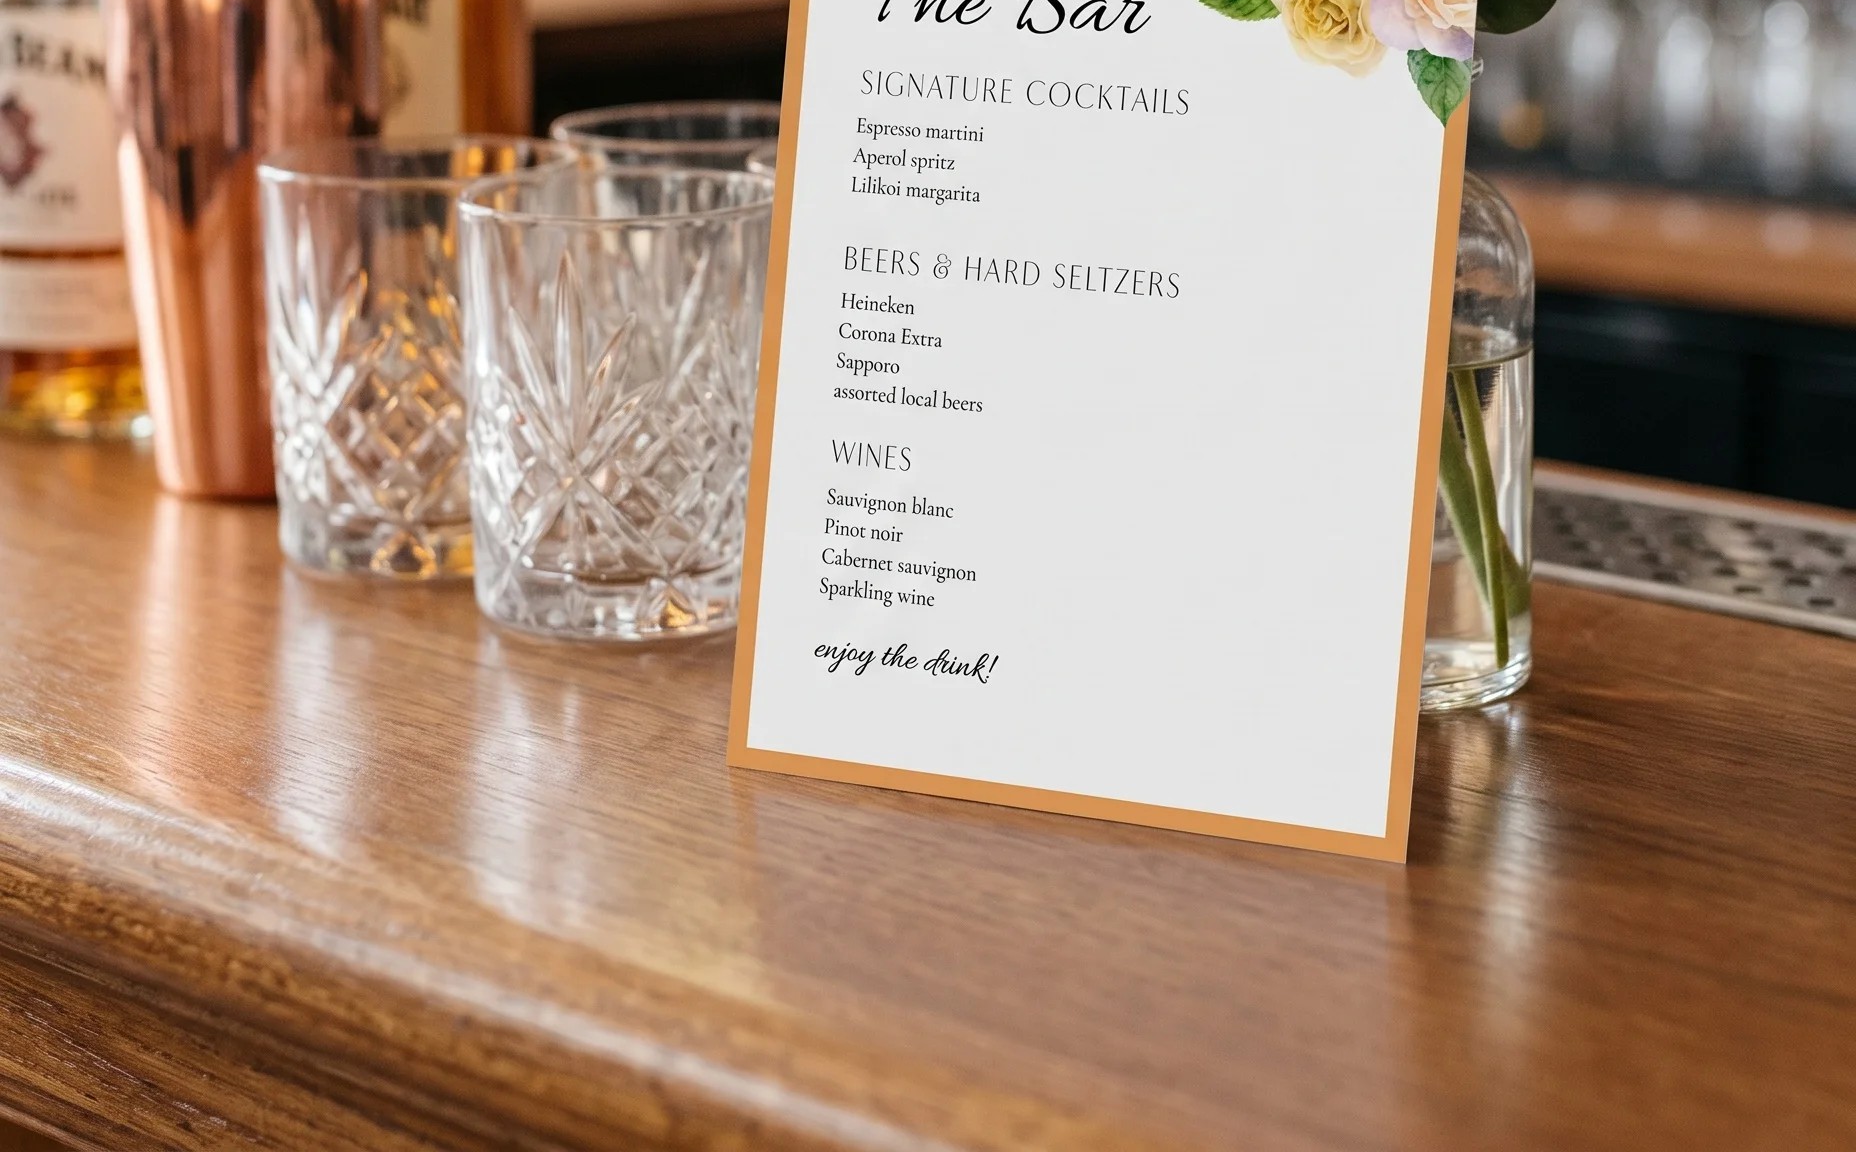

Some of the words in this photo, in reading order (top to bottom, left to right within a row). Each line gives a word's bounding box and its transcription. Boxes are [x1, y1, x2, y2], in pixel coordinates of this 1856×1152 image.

[860, 69, 1013, 104] SIGNATURE
[1026, 79, 1189, 116] COCKTAILS
[856, 117, 922, 141] Espresso
[925, 125, 984, 143] martini
[852, 147, 907, 171] Aperol
[910, 153, 956, 175] spritz
[851, 175, 901, 197] Lilikoi
[905, 185, 981, 206] margarita
[844, 245, 920, 277] BEERS
[932, 253, 952, 280] &
[964, 255, 1041, 287] HARD
[1052, 262, 1180, 299] SELTZERS
[840, 292, 915, 316] Heineken
[838, 322, 896, 344] Corona
[900, 327, 943, 348] Extra
[836, 351, 900, 378] Sapporo
[833, 385, 897, 404] assorted
[900, 386, 938, 408] local
[941, 390, 983, 413] beers
[831, 439, 912, 472] WINES
[826, 487, 907, 516] Sauvignon
[911, 495, 954, 519] blanc
[824, 517, 867, 539] Pinot
[870, 525, 904, 543] noir
[821, 547, 894, 572] Cabernet
[897, 560, 977, 584] sauvignon
[819, 576, 894, 608] Sparkling
[897, 588, 935, 607] wine
[813, 642, 877, 677] enjoy
[880, 642, 919, 670] the
[923, 648, 1000, 685] drink!
